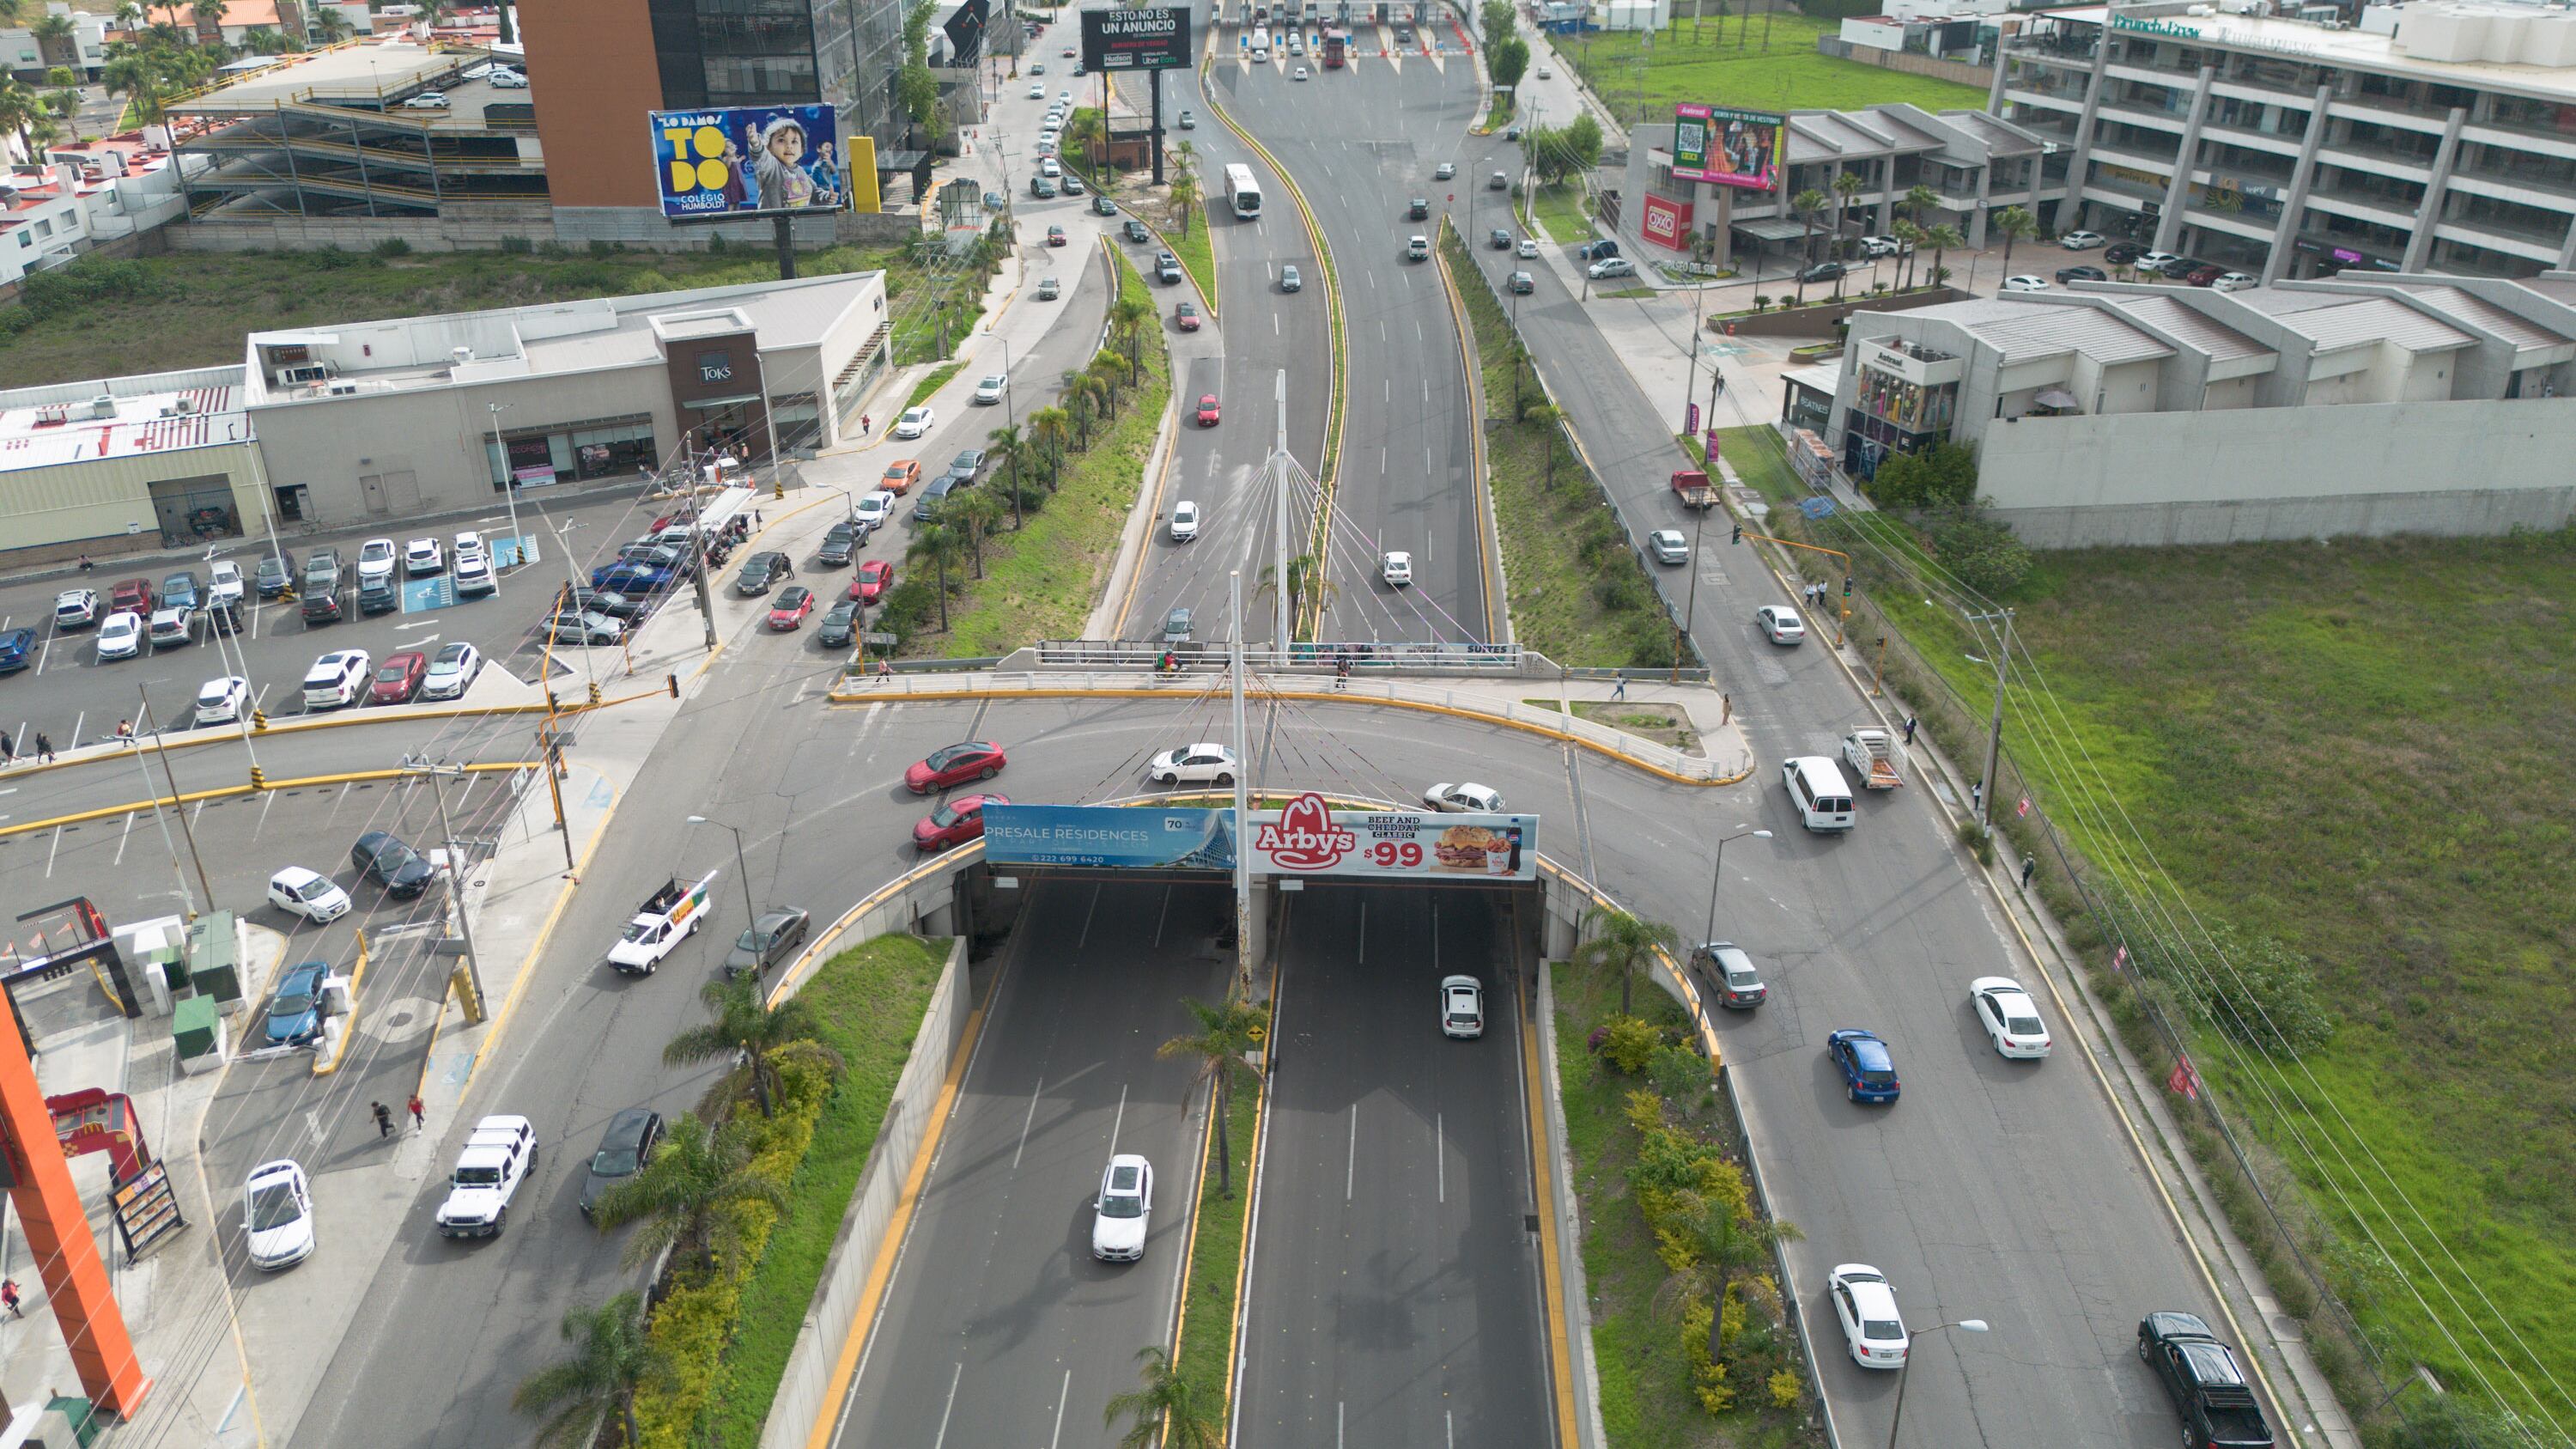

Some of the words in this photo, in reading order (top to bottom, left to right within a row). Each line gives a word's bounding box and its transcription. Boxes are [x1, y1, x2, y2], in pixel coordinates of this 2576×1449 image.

[1109, 10, 1135, 21] ESTO
[1139, 9, 1153, 20] NO
[1157, 9, 1169, 19] ES
[1102, 22, 1120, 33] UN
[1122, 19, 1176, 33] ANUNCIO
[1105, 54, 1131, 63] Hudson
[681, 115, 722, 126] DAMOS
[681, 193, 725, 204] COLEGIO
[682, 200, 725, 210] HUMBOLDT
[1649, 212, 1674, 231] OXXO
[1689, 262, 1702, 273] DEL
[1703, 264, 1717, 275] SUR
[1467, 645, 1508, 654] SUITES
[1167, 820, 1182, 829] 70
[984, 826, 1051, 839] PRESALE
[1055, 829, 1149, 841] RESIDENCES
[1259, 825, 1353, 855] Arby's
